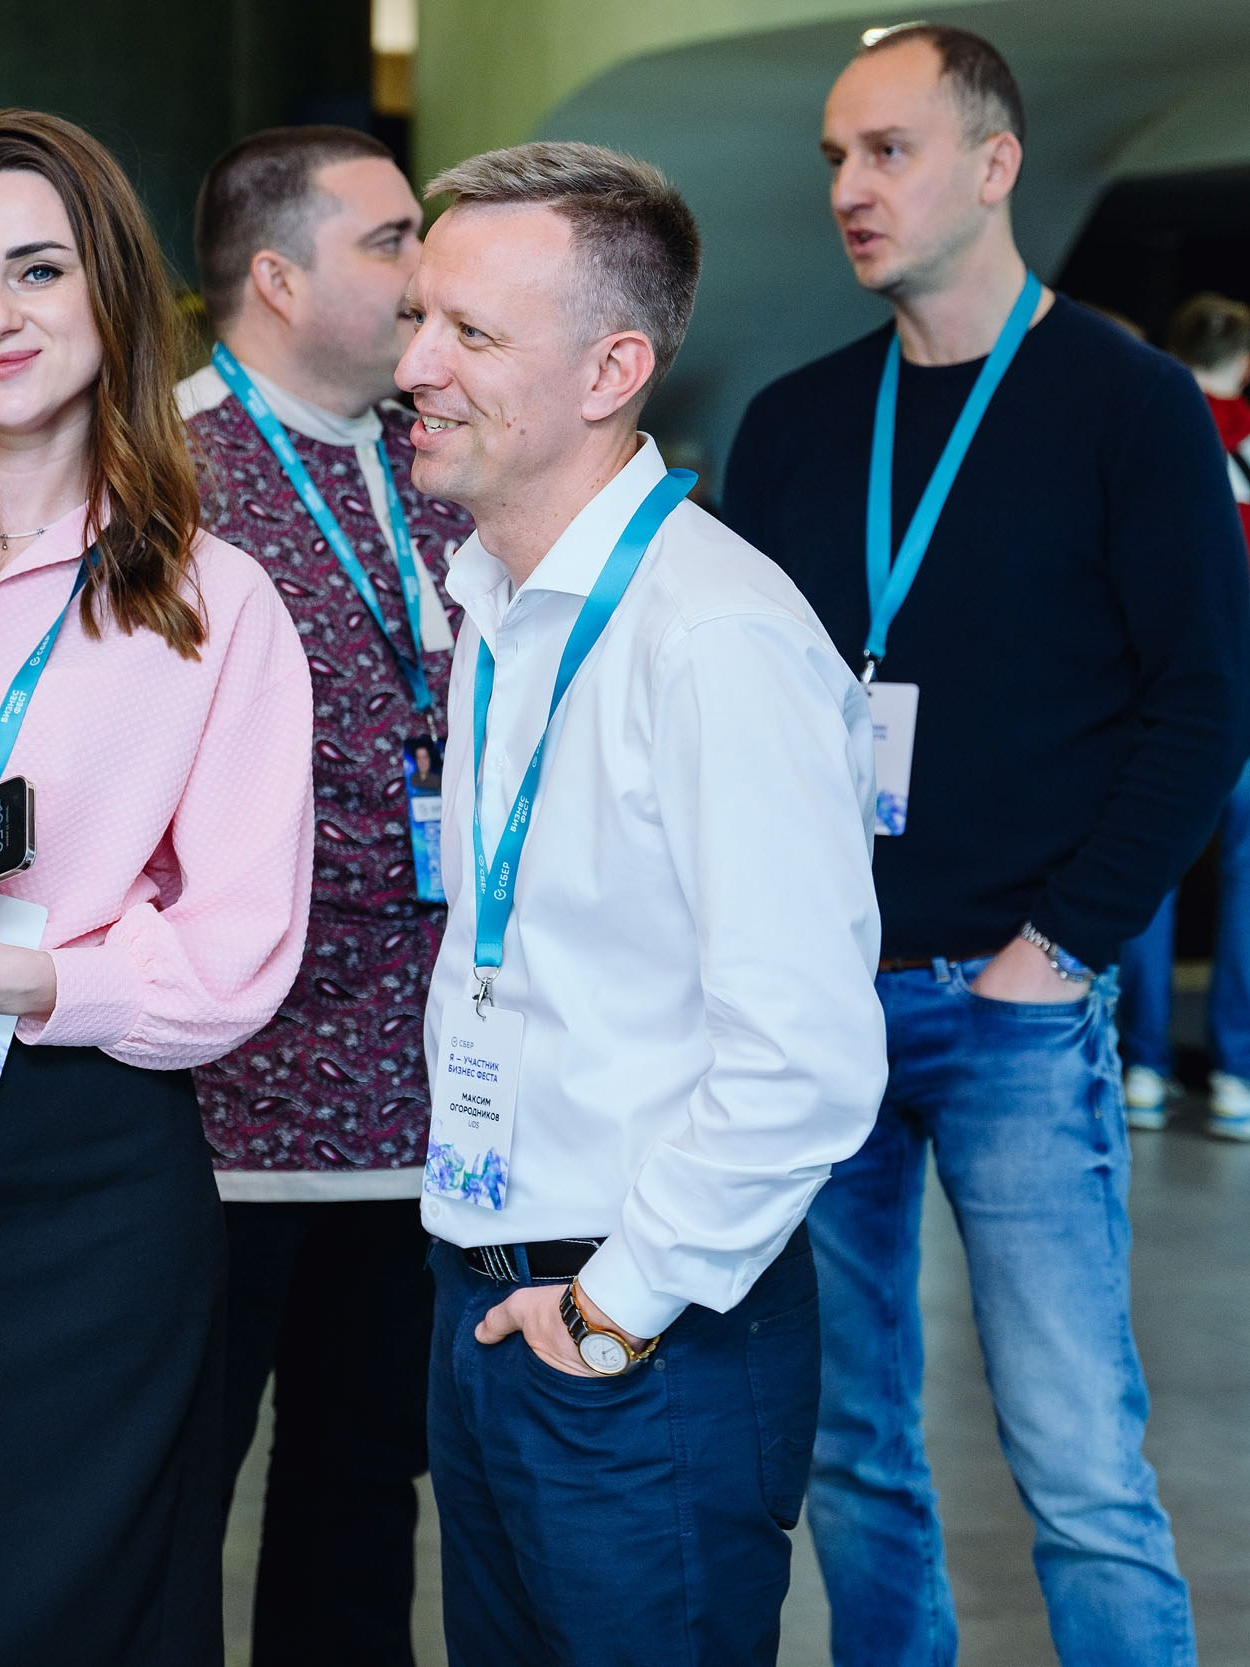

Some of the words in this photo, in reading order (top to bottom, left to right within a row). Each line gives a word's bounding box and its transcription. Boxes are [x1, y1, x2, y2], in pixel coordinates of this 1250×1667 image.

[1, 689, 20, 723] БИЗНЕС
[14, 691, 27, 714] ФЕСТ
[510, 795, 526, 832] БИЗНЕС
[520, 798, 529, 823] ФЕСТ
[499, 862, 510, 887] СБЕР
[459, 1039, 475, 1049] СБЕР
[450, 1053, 454, 1061] Я
[463, 1055, 500, 1071] УЧАСТНИК
[448, 1064, 475, 1078] БИЗНЕС
[476, 1070, 498, 1082] ФЕСТА
[461, 1092, 492, 1107] МАКСИМ
[449, 1102, 500, 1121] ОГОРОДНИКОВ
